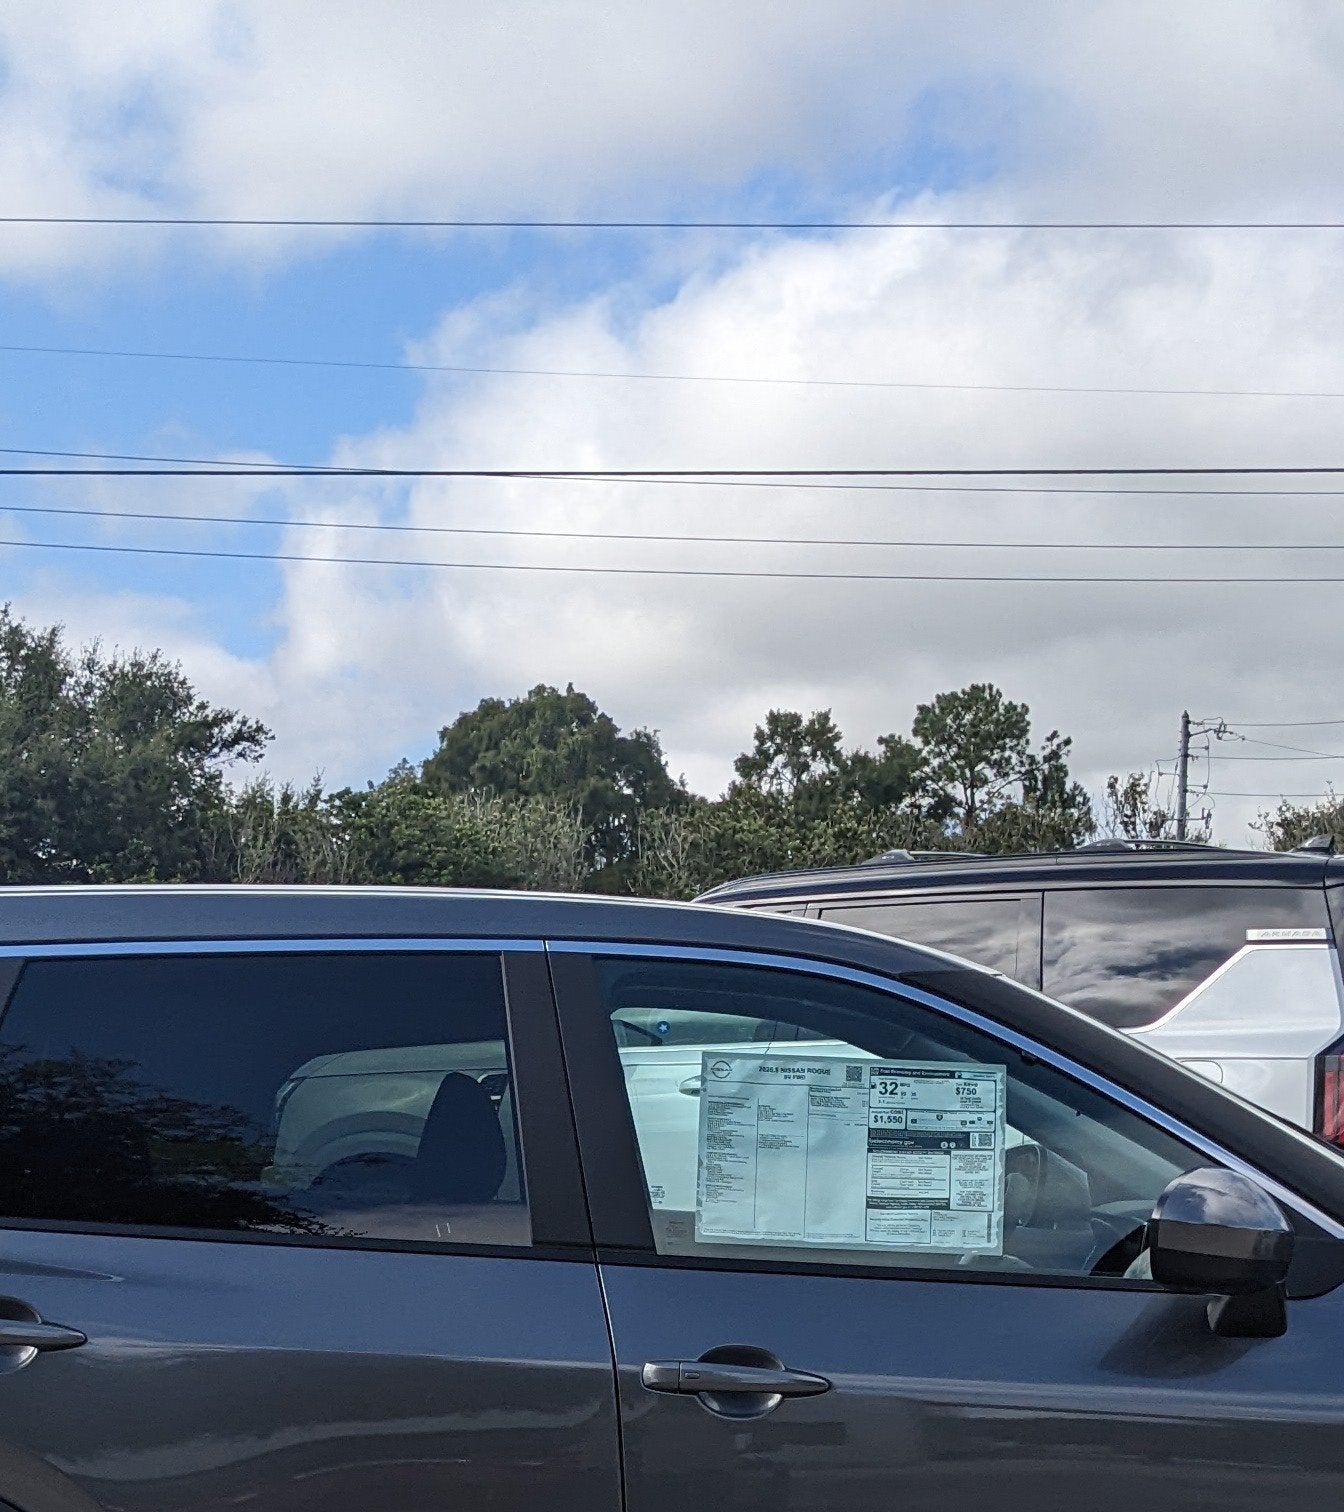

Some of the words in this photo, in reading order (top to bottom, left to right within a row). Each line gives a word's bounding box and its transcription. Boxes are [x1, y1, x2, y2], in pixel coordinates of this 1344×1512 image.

[1260, 930, 1321, 938] ARMADA
[878, 1081, 899, 1096] 32
[955, 1087, 977, 1096] $750
[873, 1115, 903, 1124] $1,550
